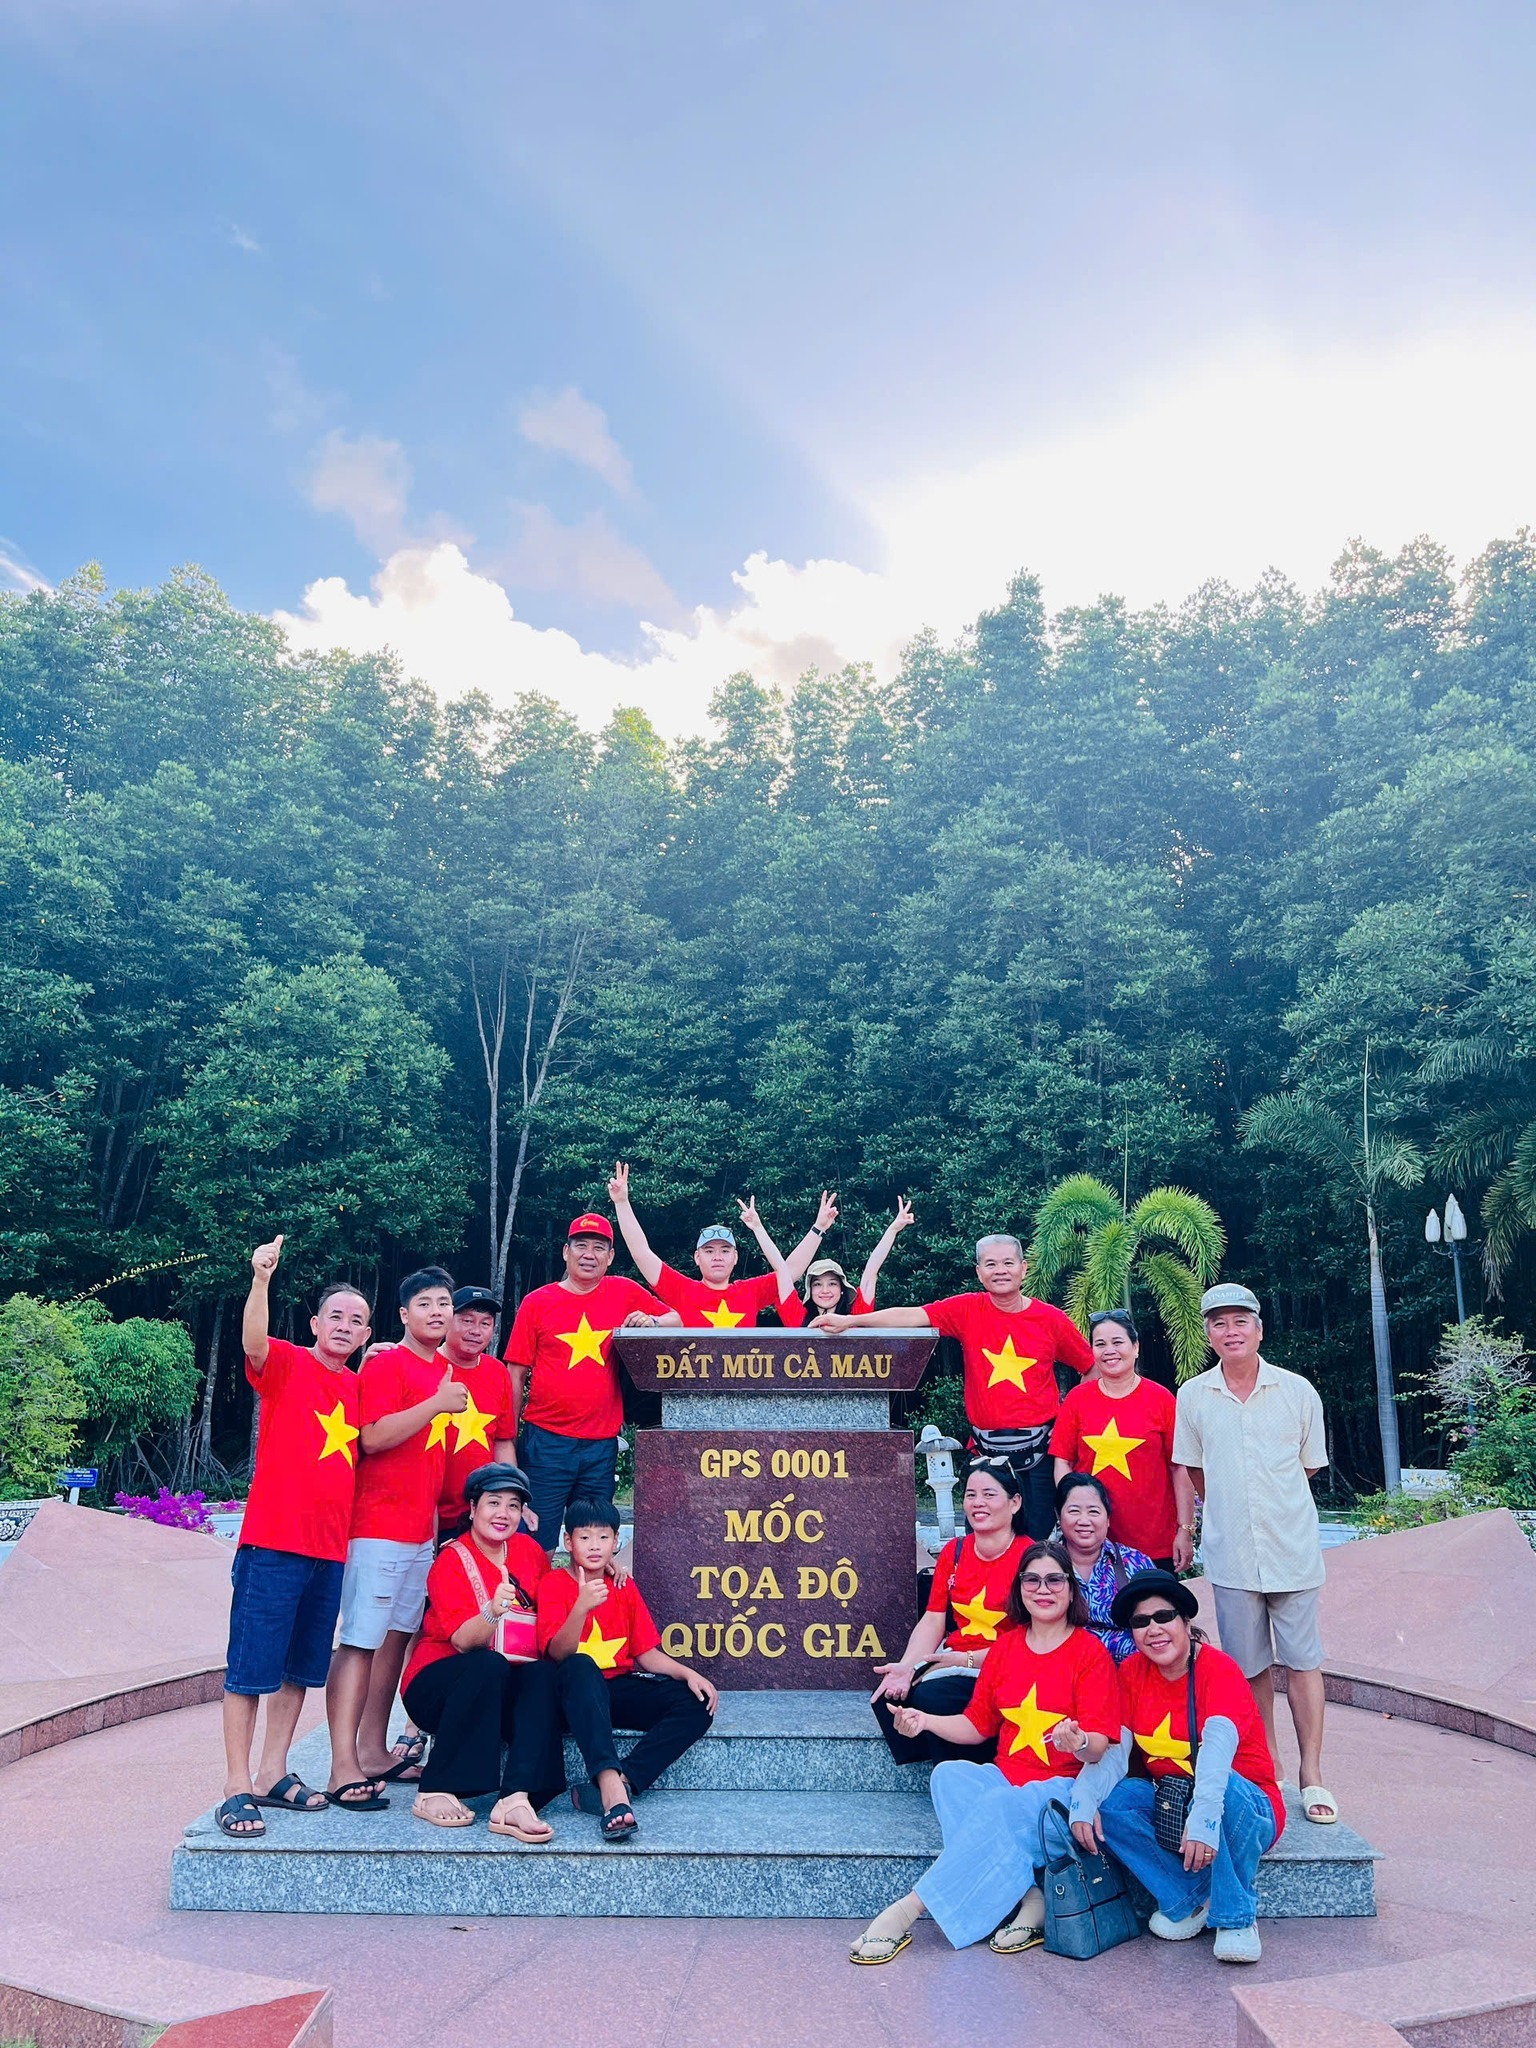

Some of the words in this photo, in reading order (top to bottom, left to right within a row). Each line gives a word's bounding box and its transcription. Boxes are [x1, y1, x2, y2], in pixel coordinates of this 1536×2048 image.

[656, 1343, 713, 1378] ĐẤT
[722, 1347, 774, 1378] MŨI
[784, 1347, 822, 1378] CÀ
[831, 1355, 892, 1378] MAU
[700, 1449, 761, 1478] GPS
[771, 1449, 849, 1478] 0001
[724, 1493, 824, 1543] MỐC
[690, 1566, 784, 1607] TỌA
[797, 1558, 859, 1607] ĐỘ
[661, 1607, 786, 1658] QUỐC
[803, 1623, 886, 1658] GIA
